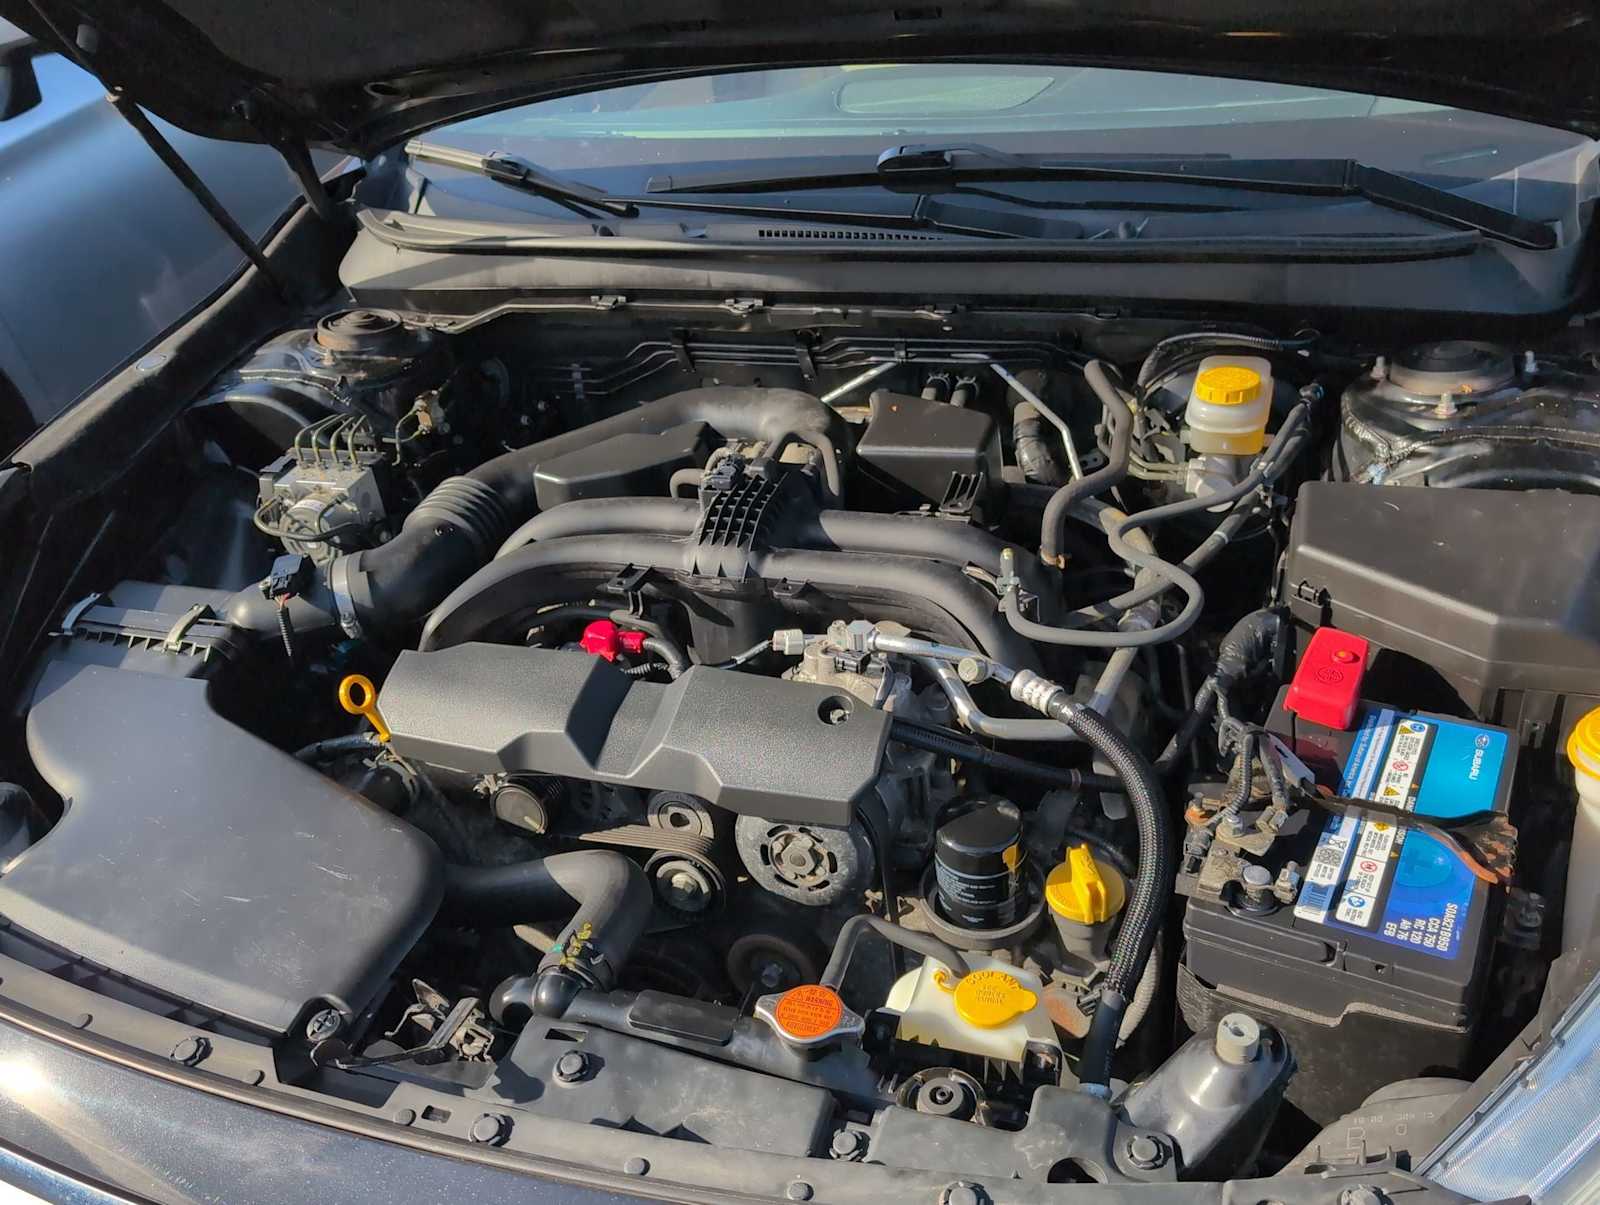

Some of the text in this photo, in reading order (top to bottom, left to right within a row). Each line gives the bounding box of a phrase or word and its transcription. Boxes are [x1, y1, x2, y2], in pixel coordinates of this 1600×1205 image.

[1469, 749, 1484, 780] SUBARU
[1383, 922, 1397, 937] EFB
[1400, 918, 1412, 930] Ah
[1410, 918, 1426, 944] RC 120
[1424, 918, 1441, 948] CCA 750
